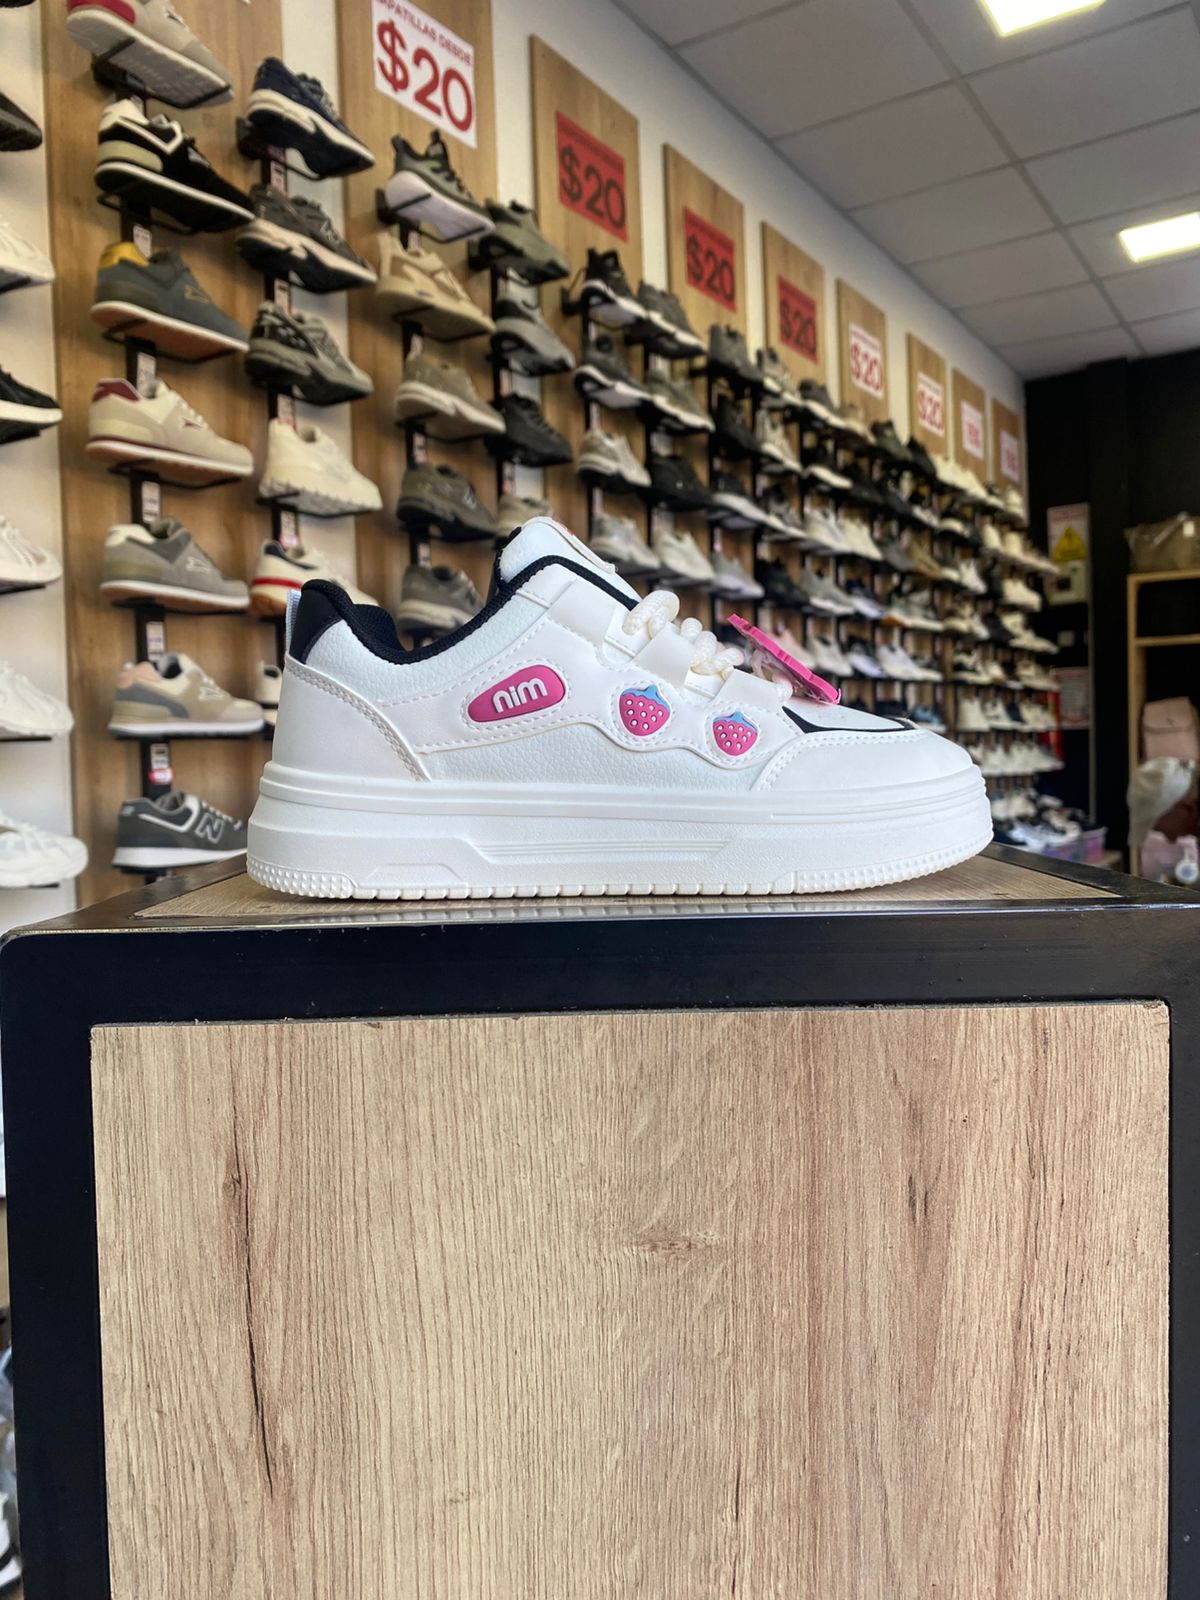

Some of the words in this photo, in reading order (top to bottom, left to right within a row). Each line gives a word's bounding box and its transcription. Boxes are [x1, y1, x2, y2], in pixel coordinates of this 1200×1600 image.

[377, 19, 473, 132] $20
[560, 145, 625, 229] $20
[687, 234, 736, 302] $20
[779, 299, 817, 356] $20
[851, 344, 883, 392] $20
[493, 678, 548, 713] nim
